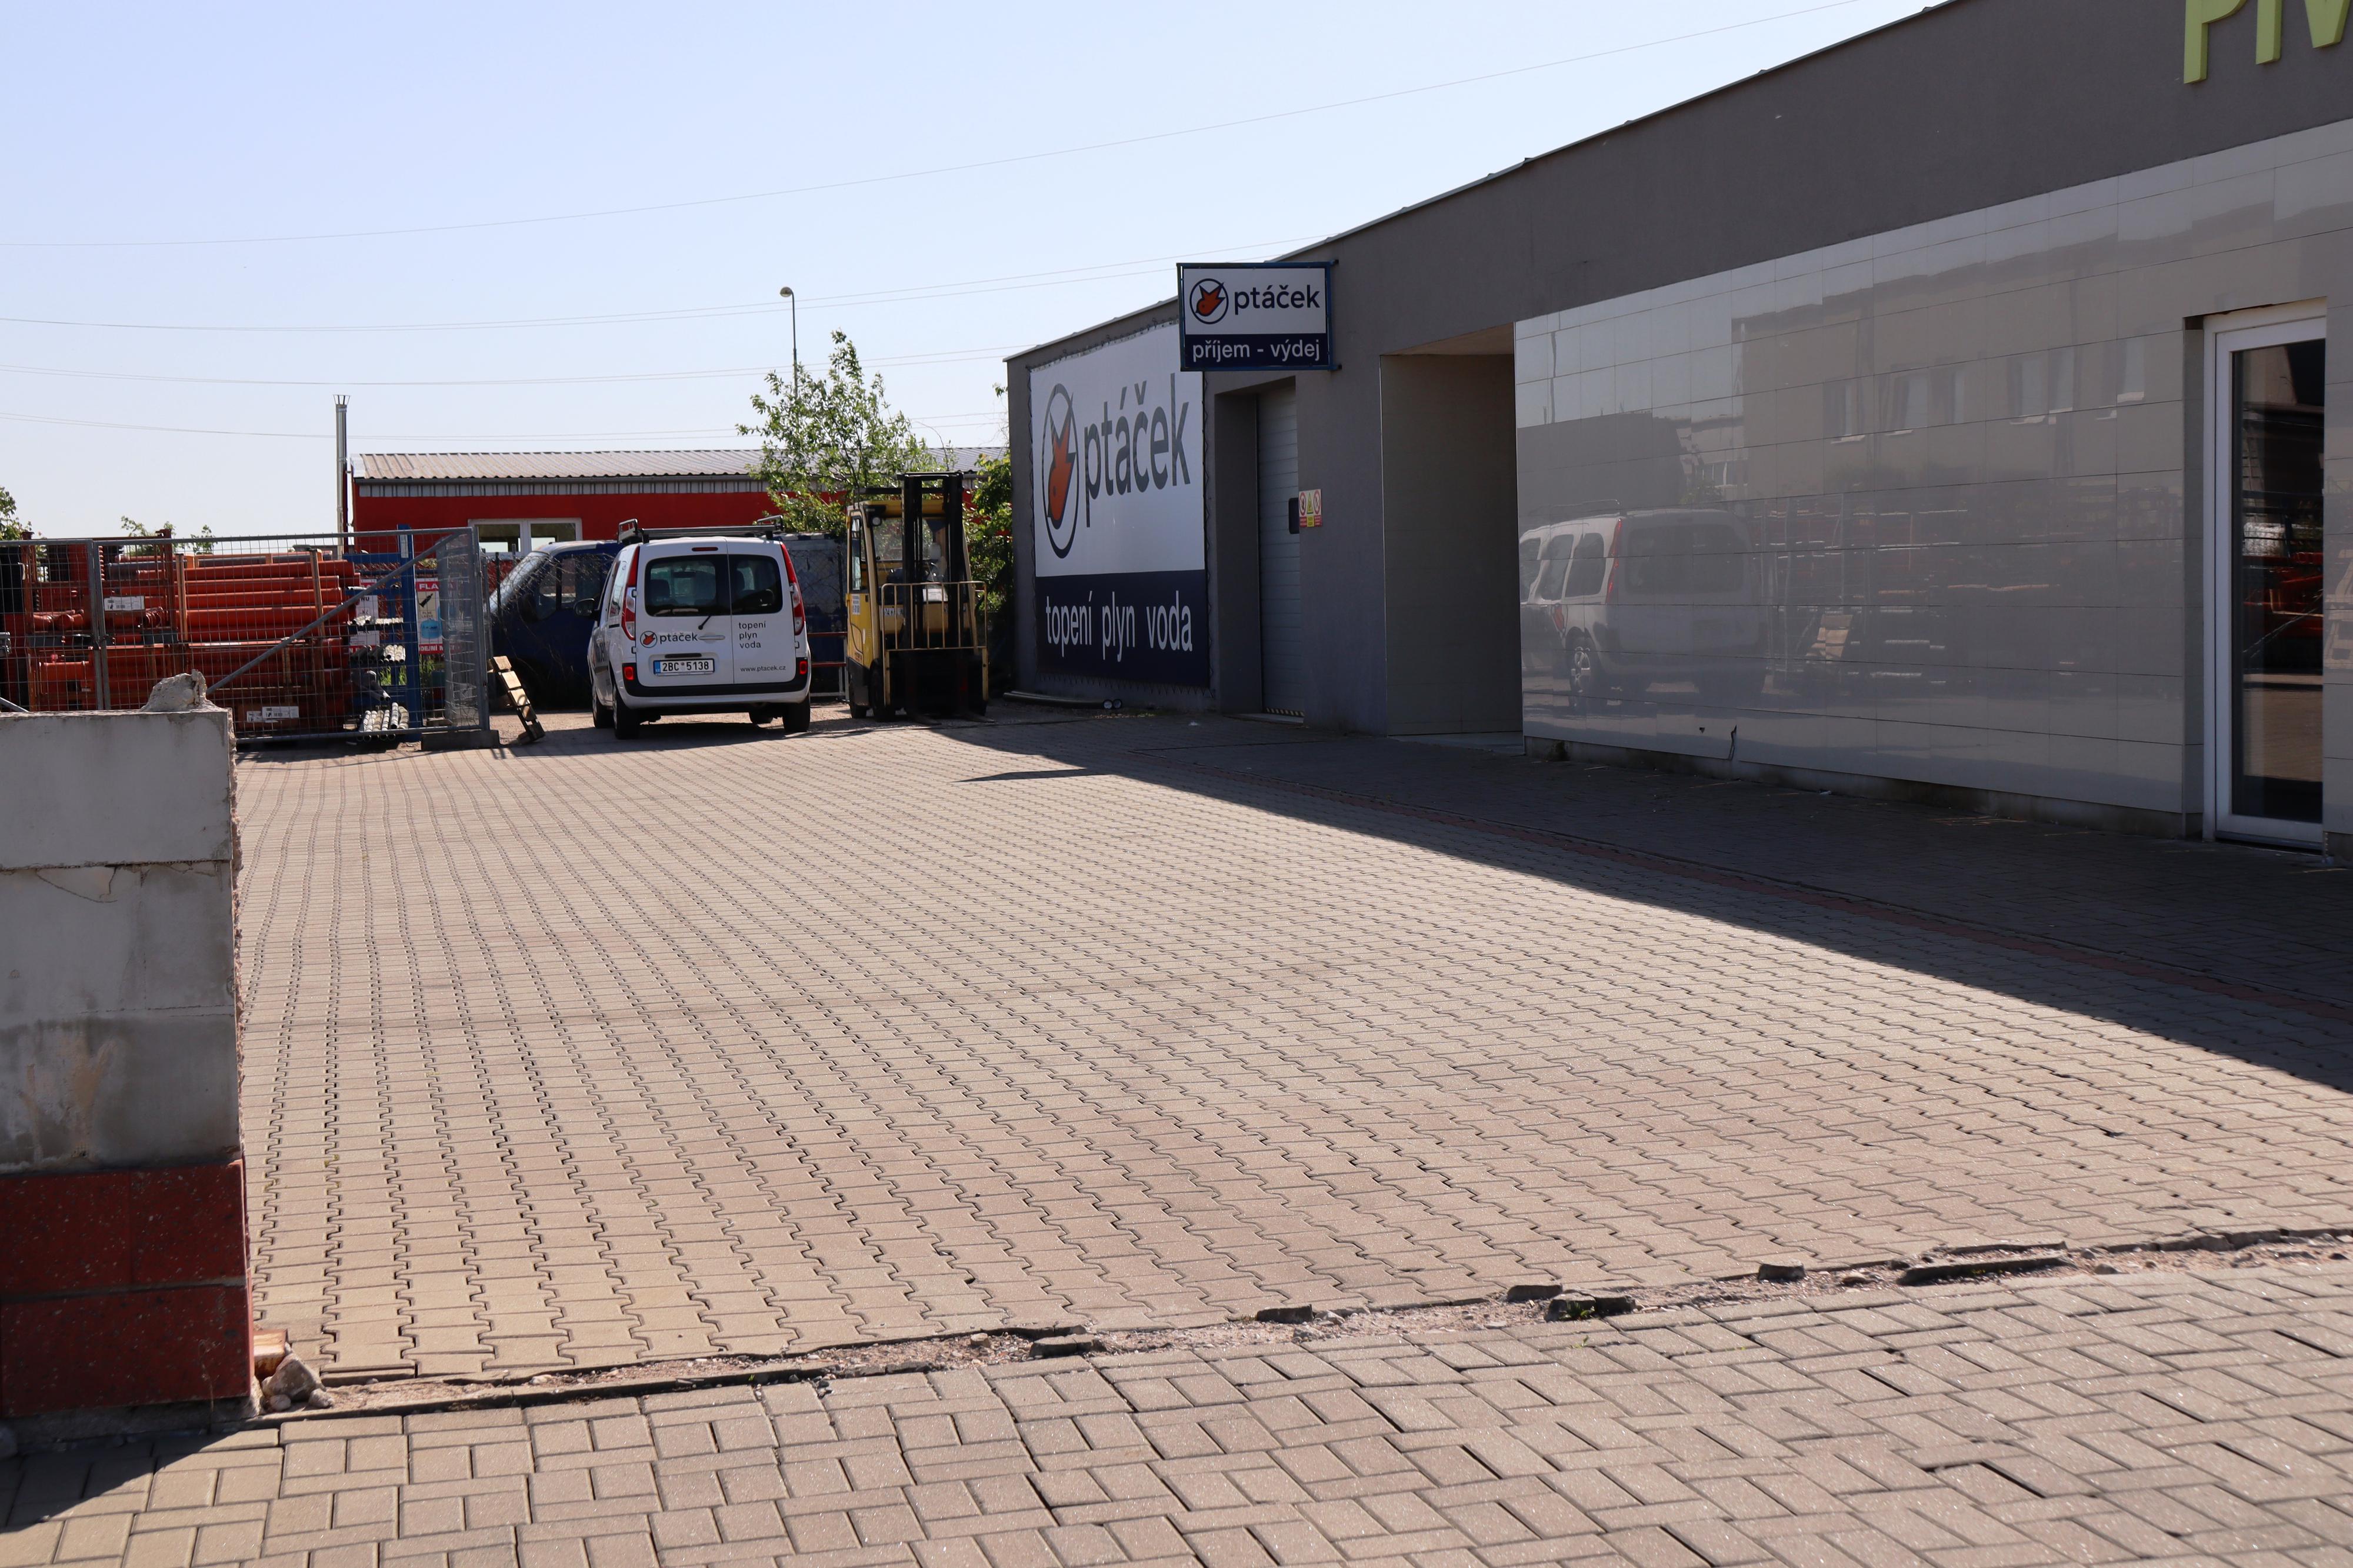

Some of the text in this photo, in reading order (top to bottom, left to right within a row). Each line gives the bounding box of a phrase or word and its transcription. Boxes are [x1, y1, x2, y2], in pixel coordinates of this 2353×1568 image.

[1235, 285, 1321, 315] ptáček
[1193, 339, 1250, 362] příjem
[1270, 339, 1320, 362] výdej
[1084, 372, 1191, 528] ptáček
[739, 620, 766, 630] topení
[1045, 590, 1193, 662] topení plyn voda
[659, 632, 698, 645] ptáček
[739, 632, 758, 640] plyn
[739, 640, 761, 649] voda
[662, 662, 679, 672] 2BC
[686, 661, 709, 670] 5138
